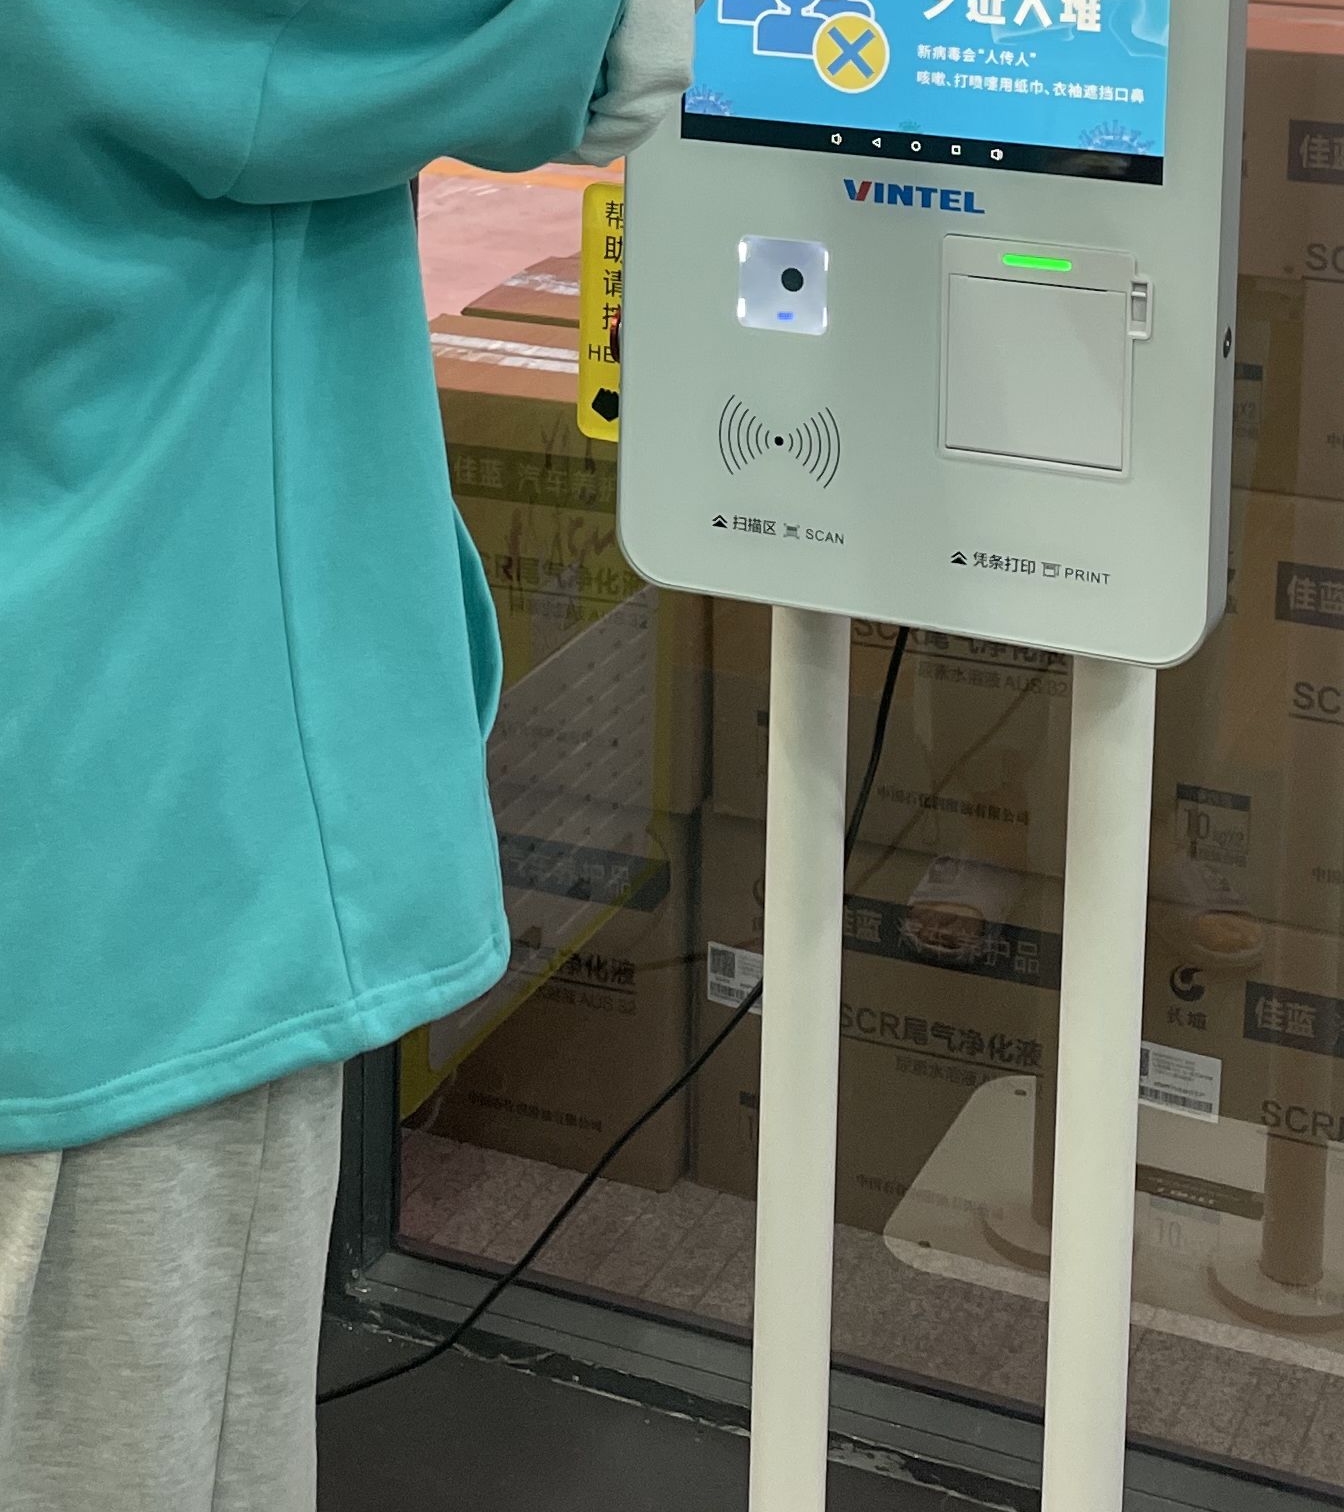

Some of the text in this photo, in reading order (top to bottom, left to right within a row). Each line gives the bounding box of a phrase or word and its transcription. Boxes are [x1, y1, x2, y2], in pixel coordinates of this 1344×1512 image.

[843, 178, 985, 215] VINTEL
[732, 514, 845, 546] 扫描区 SCAN
[972, 550, 1111, 585] 凭条打印 PRINT
